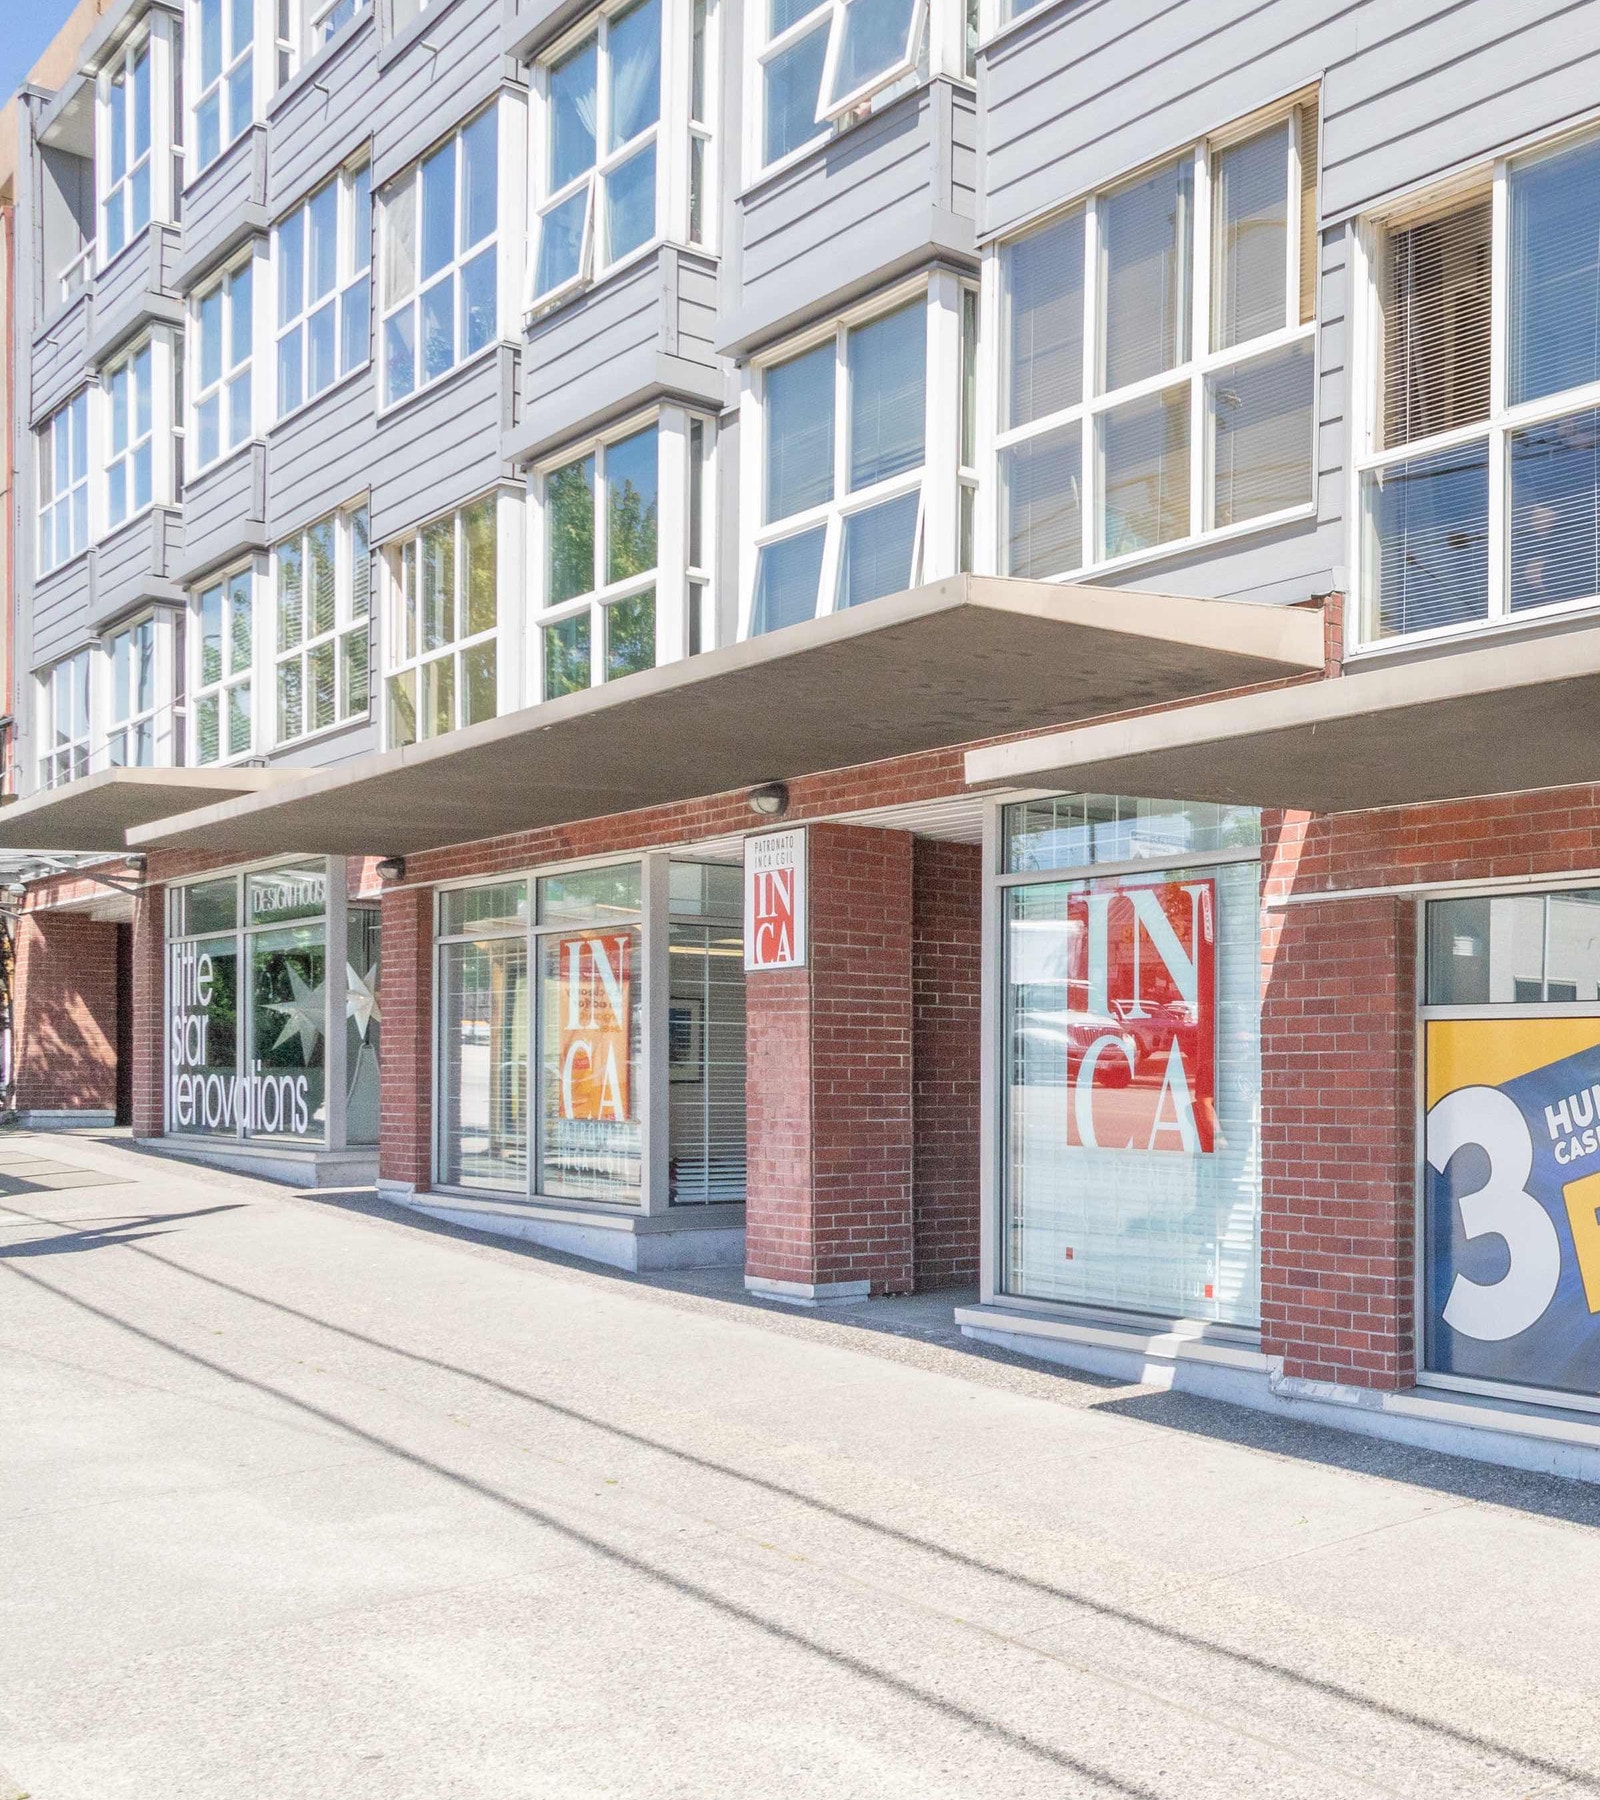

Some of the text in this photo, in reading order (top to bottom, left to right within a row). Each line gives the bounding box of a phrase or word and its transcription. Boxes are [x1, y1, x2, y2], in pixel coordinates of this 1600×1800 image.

[754, 835, 794, 854] PATRONATO
[754, 851, 793, 868] INCA CGIL
[294, 879, 326, 906] HOUS
[171, 941, 214, 1007] little
[171, 1004, 209, 1067] star
[171, 1058, 309, 1134] renovations
[1426, 1084, 1561, 1342] 3
